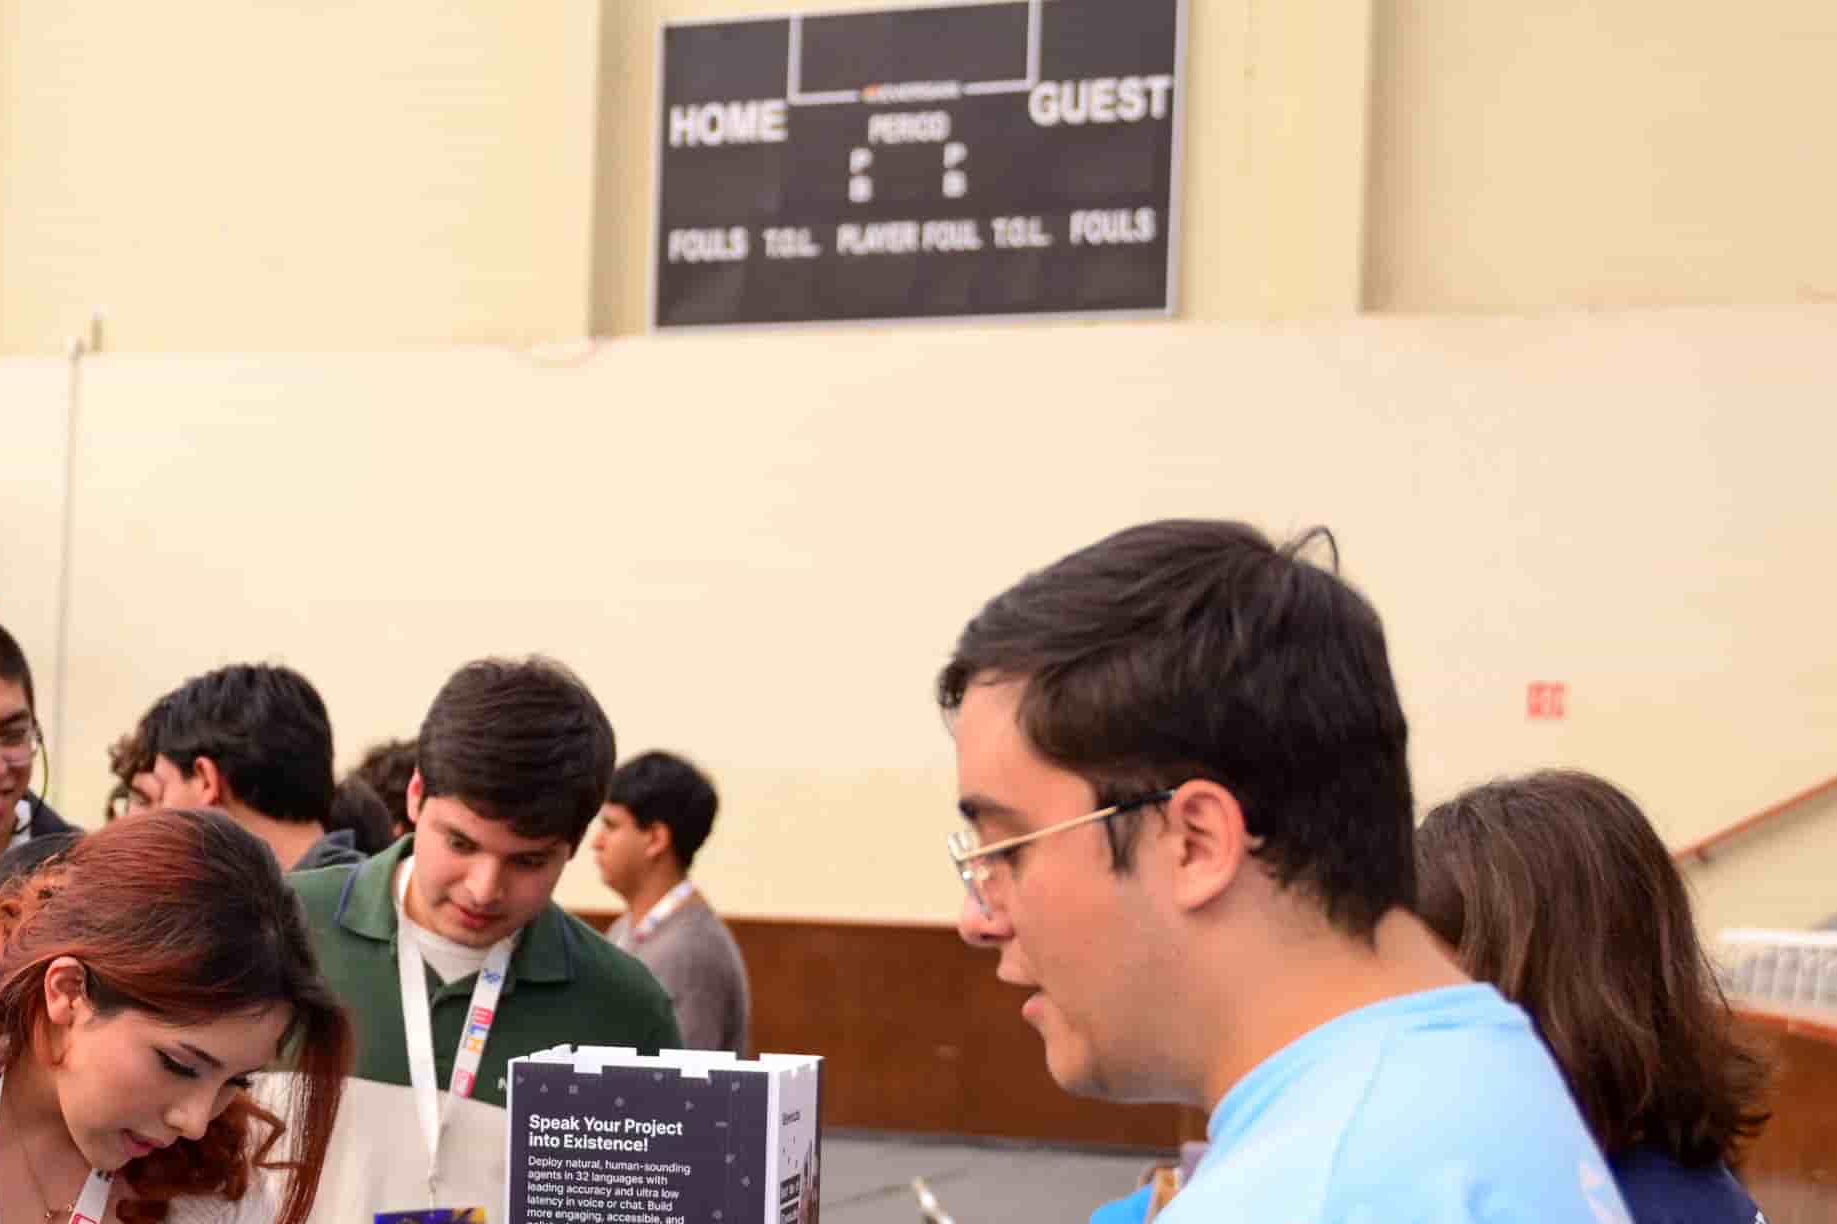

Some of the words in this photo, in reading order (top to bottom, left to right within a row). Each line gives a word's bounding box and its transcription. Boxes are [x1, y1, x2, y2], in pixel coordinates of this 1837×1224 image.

[1029, 74, 1173, 127] GUEST
[669, 101, 788, 147] HOME
[868, 110, 951, 145] PERIOD
[837, 220, 918, 255] PLAYER
[921, 220, 982, 252] FOUL
[1071, 208, 1156, 245] FOULS
[669, 227, 748, 262] FOULS
[529, 1114, 580, 1132] Speak
[584, 1116, 621, 1132] Your
[624, 1118, 683, 1137] Project
[529, 1132, 560, 1148] into
[563, 1134, 648, 1151] Existence!
[528, 1156, 563, 1168] Deploy
[565, 1158, 602, 1169] natural,
[605, 1160, 691, 1175] human-sounding
[528, 1171, 562, 1182] agents
[565, 1170, 573, 1180] in
[575, 1171, 589, 1181] 32
[591, 1172, 643, 1185] languages
[646, 1175, 668, 1185] with
[527, 1182, 564, 1195] leading
[566, 1185, 612, 1197] accuracy
[614, 1186, 633, 1196] and
[636, 1187, 658, 1197] ultra
[661, 1188, 679, 1198] low
[527, 1195, 564, 1207] latency
[566, 1196, 575, 1206] in
[578, 1198, 604, 1208] voice
[606, 1200, 617, 1208] or
[647, 1200, 673, 1211] Build
[526, 1209, 553, 1218] more
[555, 1210, 604, 1222] engaging,
[607, 1212, 663, 1224] accessible,
[665, 1215, 684, 1224] and
